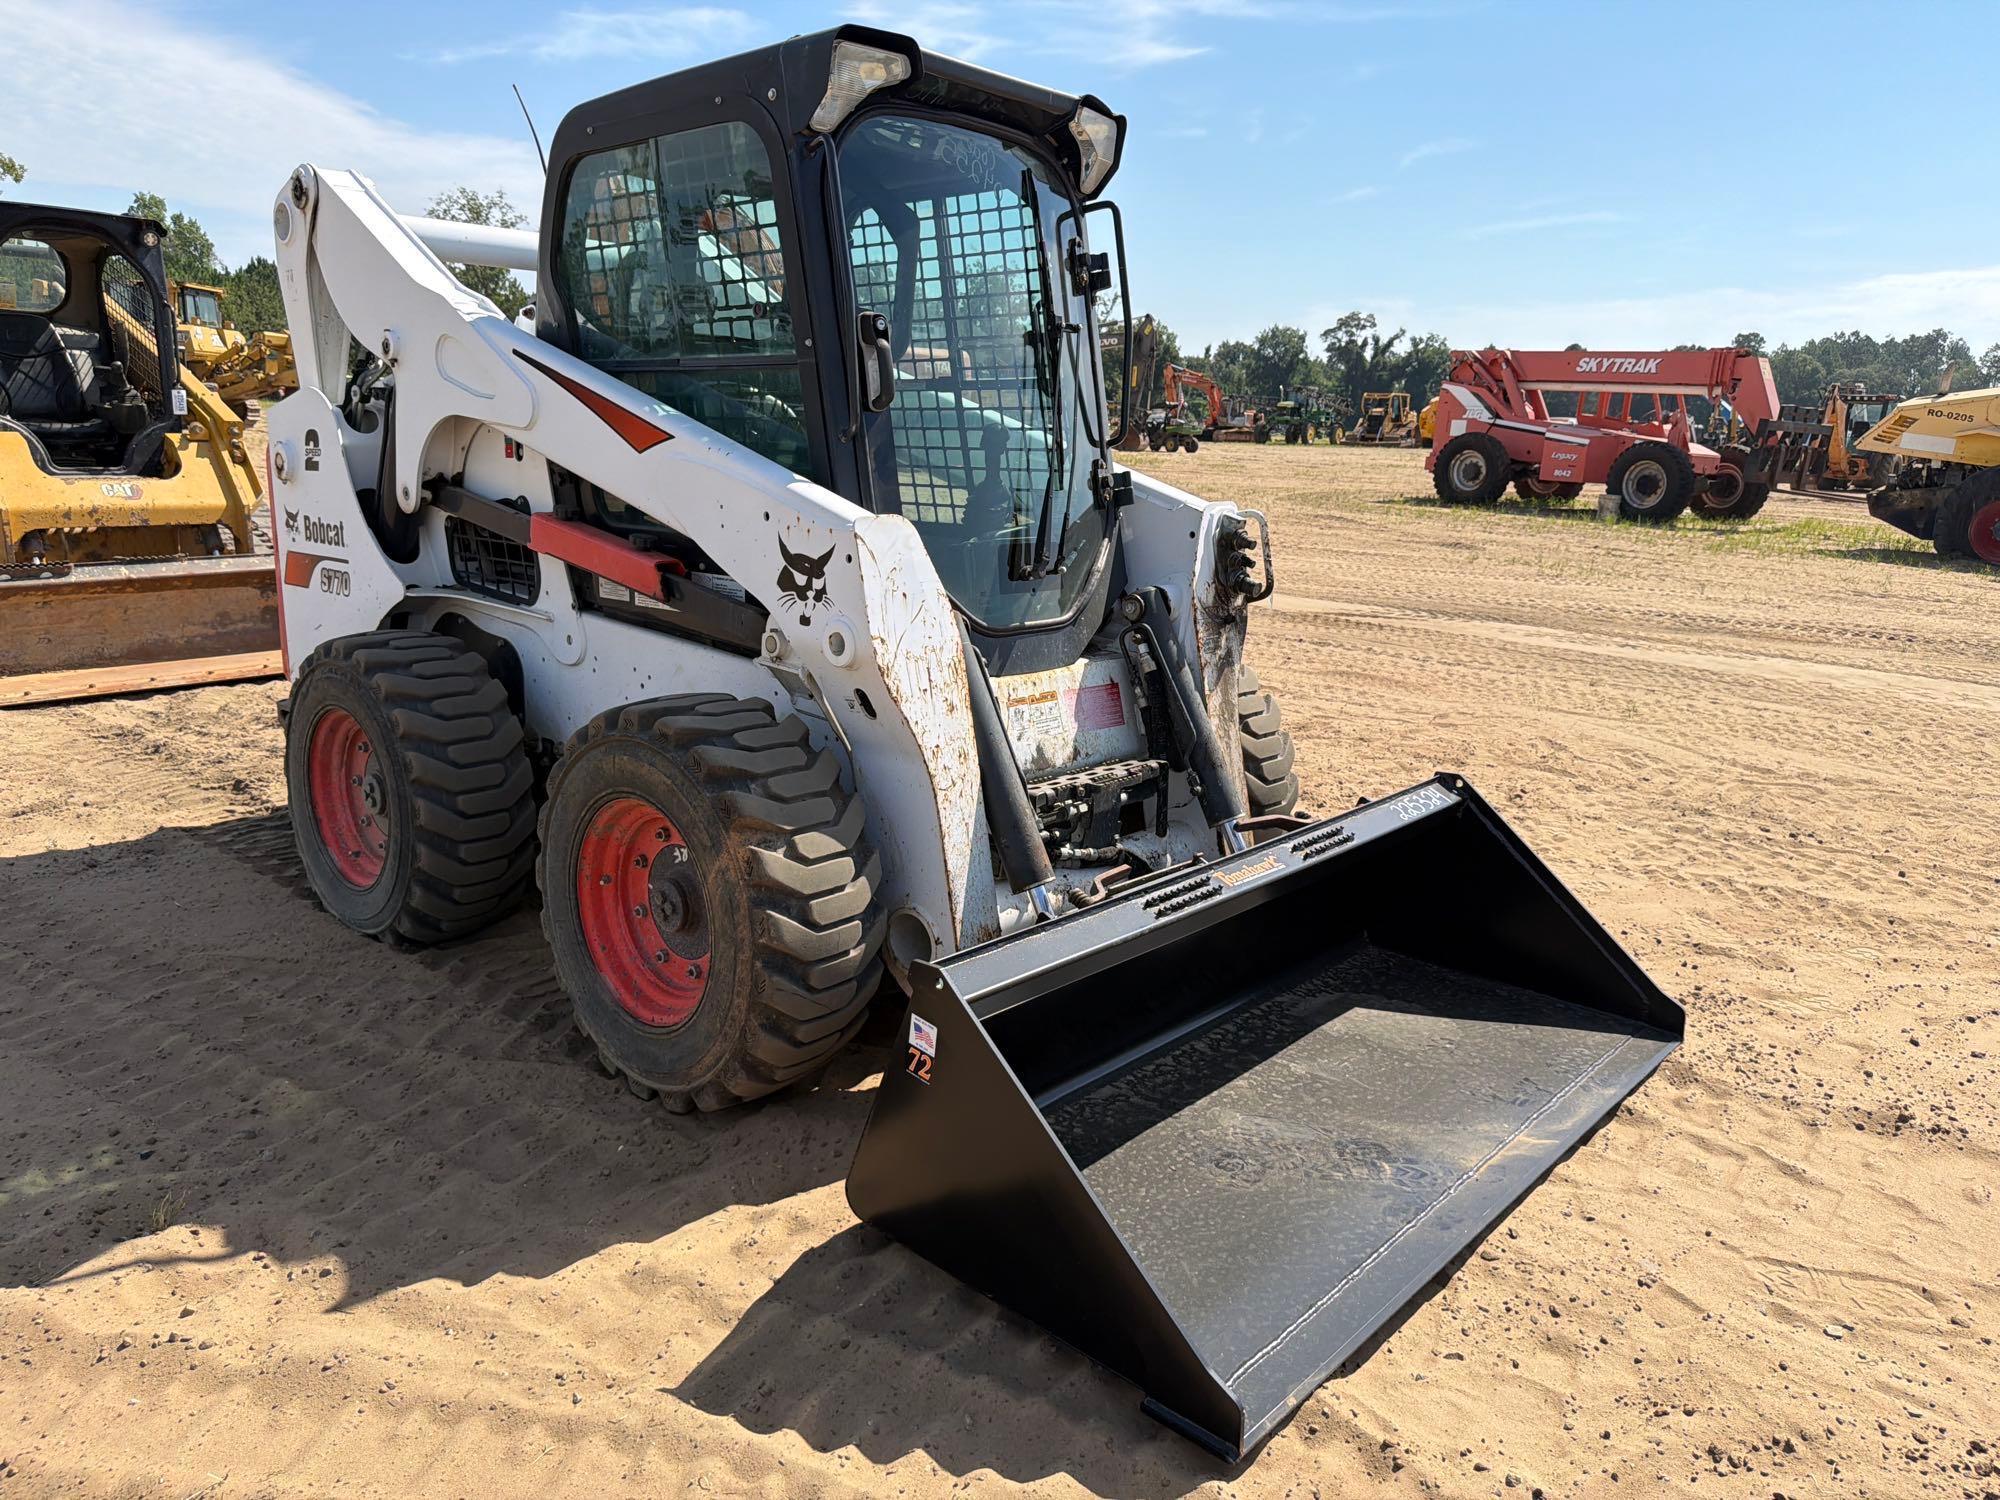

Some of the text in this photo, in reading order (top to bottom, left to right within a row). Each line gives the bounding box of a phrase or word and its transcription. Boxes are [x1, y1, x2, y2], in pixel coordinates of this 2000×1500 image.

[1575, 357, 1664, 374] SKYTRAK
[1927, 409, 1975, 423] RO-0205
[304, 448, 321, 457] SPEED
[1551, 451, 1578, 461] Legacy
[101, 483, 134, 497] CAT
[303, 514, 345, 548] Bobcat
[320, 567, 351, 597] S770
[1389, 786, 1453, 821] 225324
[908, 1046, 932, 1081] 72
